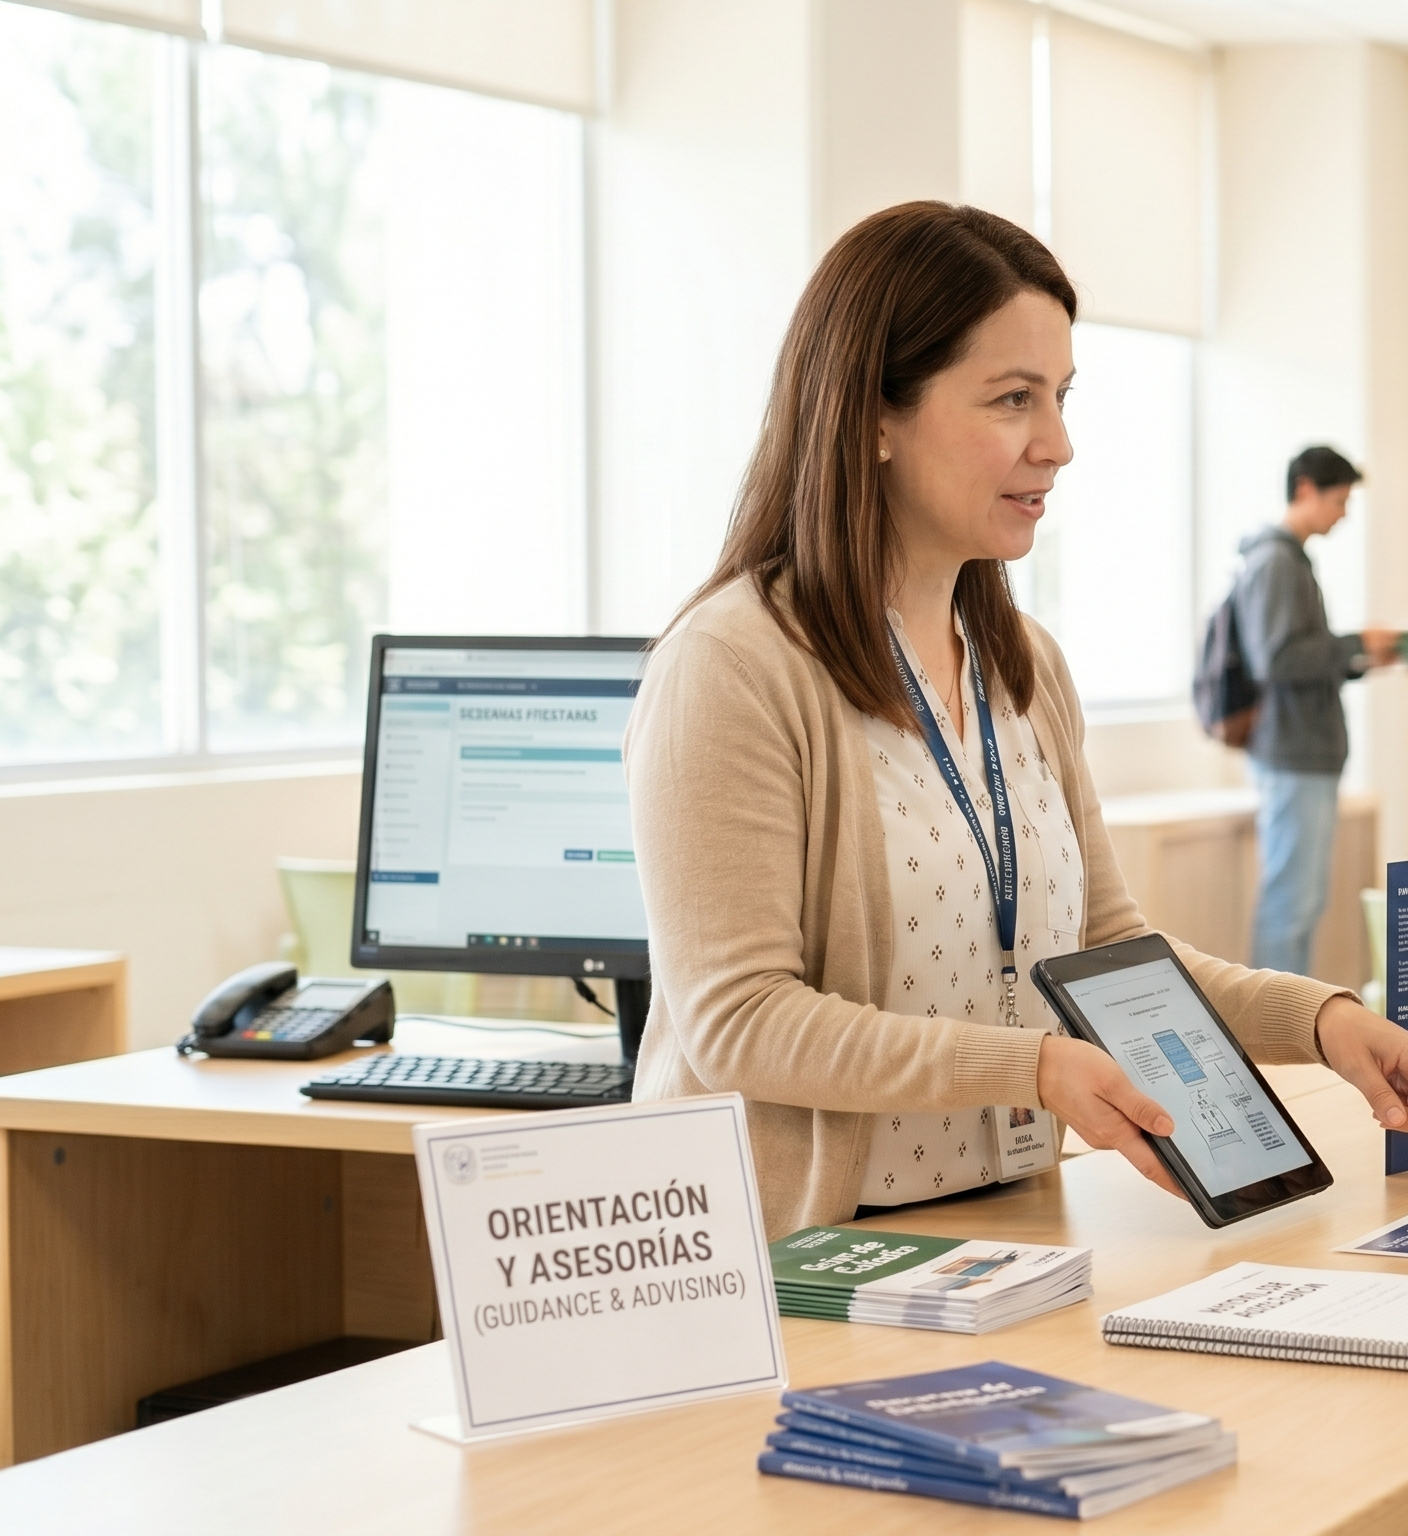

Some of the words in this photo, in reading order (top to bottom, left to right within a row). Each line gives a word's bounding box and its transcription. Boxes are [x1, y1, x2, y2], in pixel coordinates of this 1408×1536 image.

[487, 1178, 709, 1241] ORIENTACIÓN
[496, 1255, 516, 1288] Y
[530, 1227, 713, 1285] ASESORÍAS
[473, 1290, 603, 1332] (GUIDANCE
[610, 1287, 625, 1312] &
[632, 1269, 746, 1308] ADVISING)
